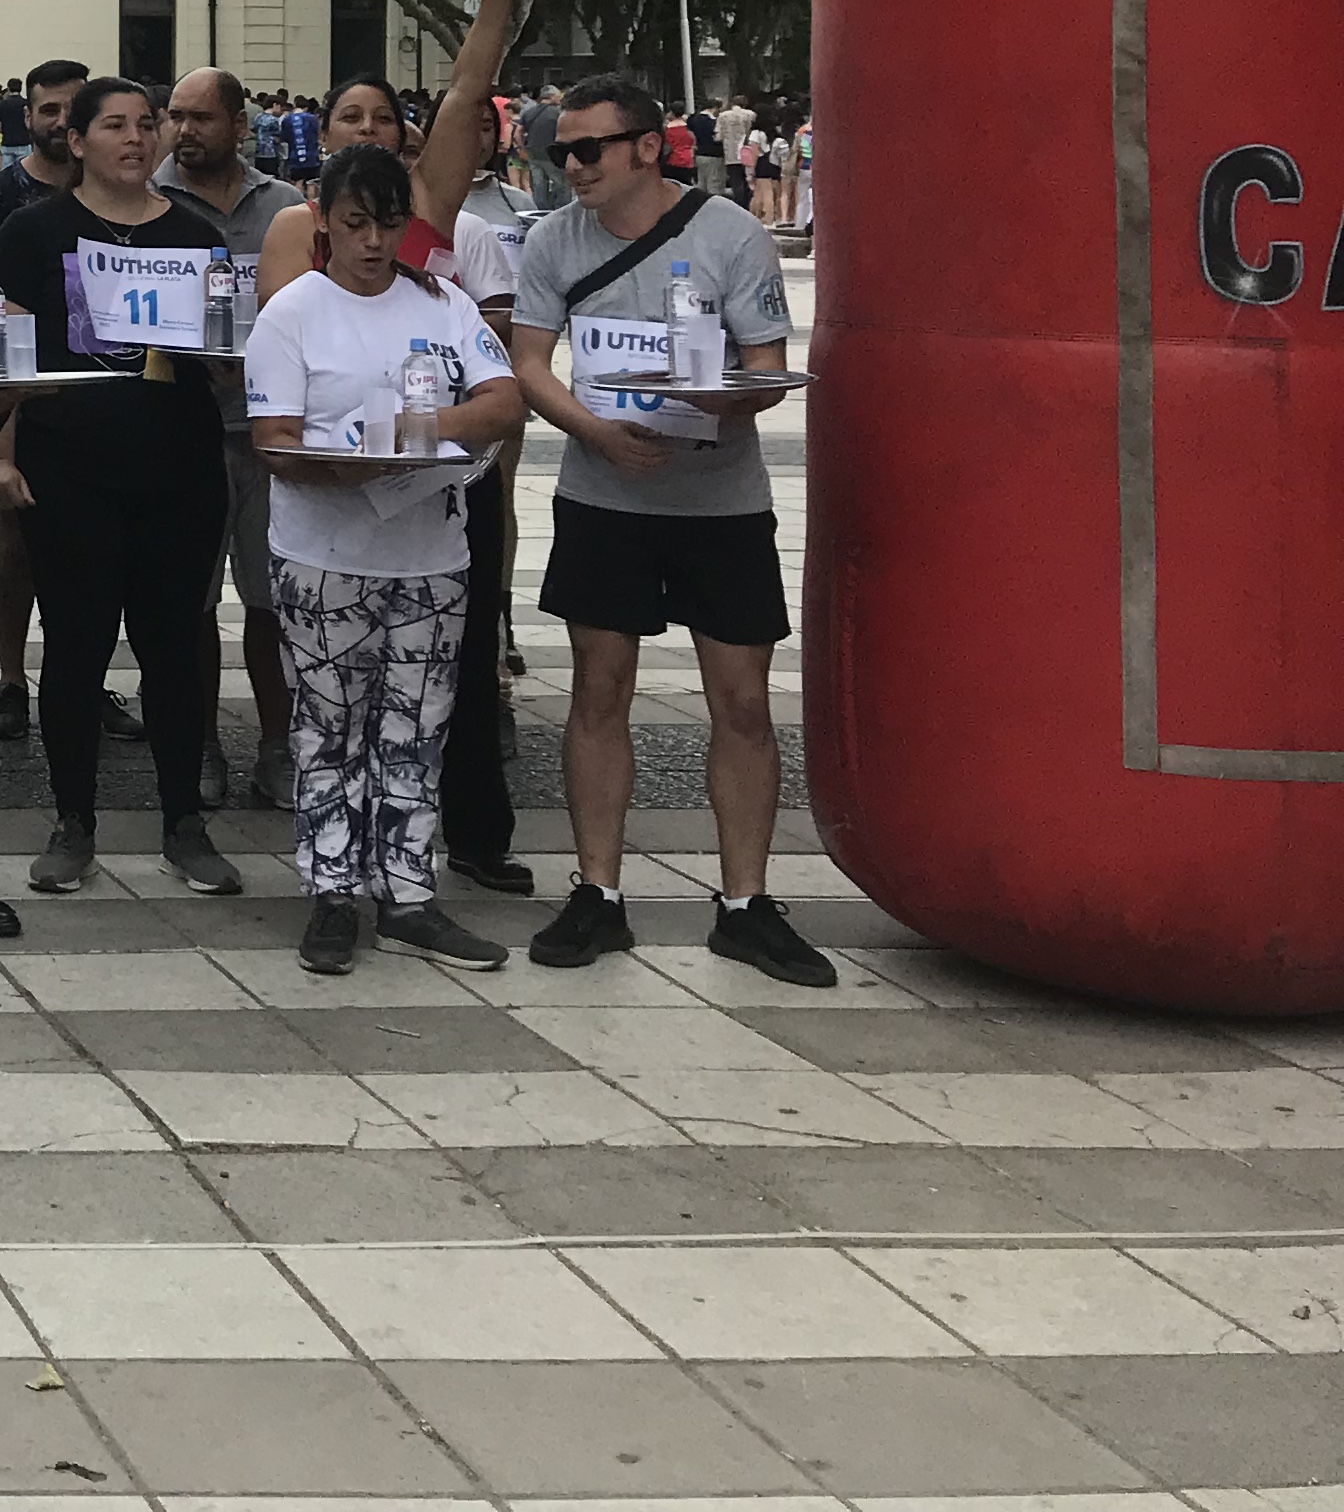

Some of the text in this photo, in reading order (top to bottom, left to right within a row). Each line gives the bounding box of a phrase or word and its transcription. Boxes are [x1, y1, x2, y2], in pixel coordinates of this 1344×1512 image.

[111, 256, 198, 276] UTHGRA
[123, 289, 158, 326] 11
[607, 331, 669, 353] UTHG
